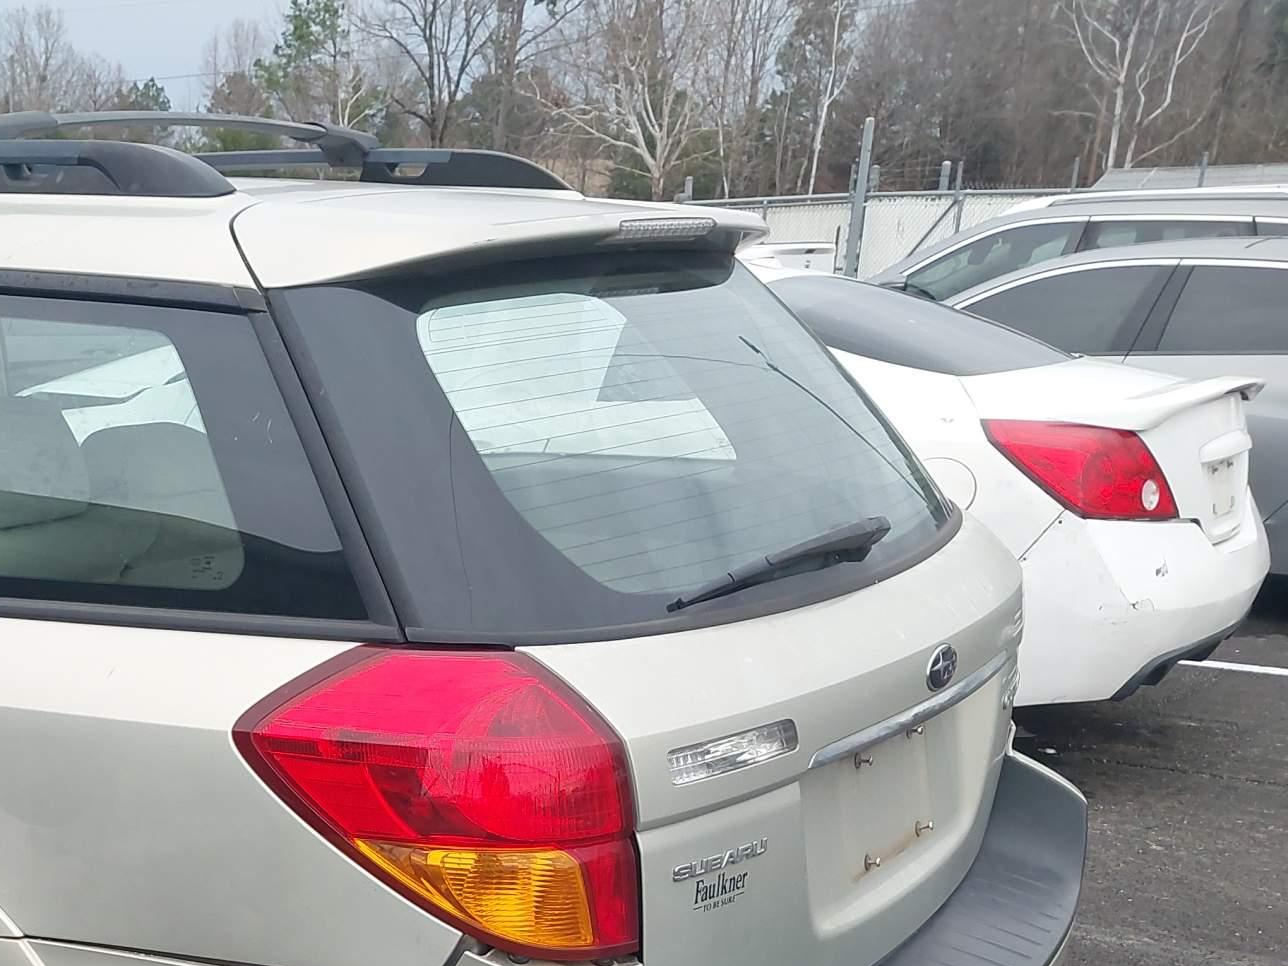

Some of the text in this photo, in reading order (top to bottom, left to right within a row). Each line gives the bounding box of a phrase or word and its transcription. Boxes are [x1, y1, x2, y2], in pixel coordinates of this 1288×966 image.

[672, 837, 768, 882] SUBARU
[693, 871, 748, 905] Faulkner
[703, 903, 712, 912] TO
[713, 900, 720, 910] BE
